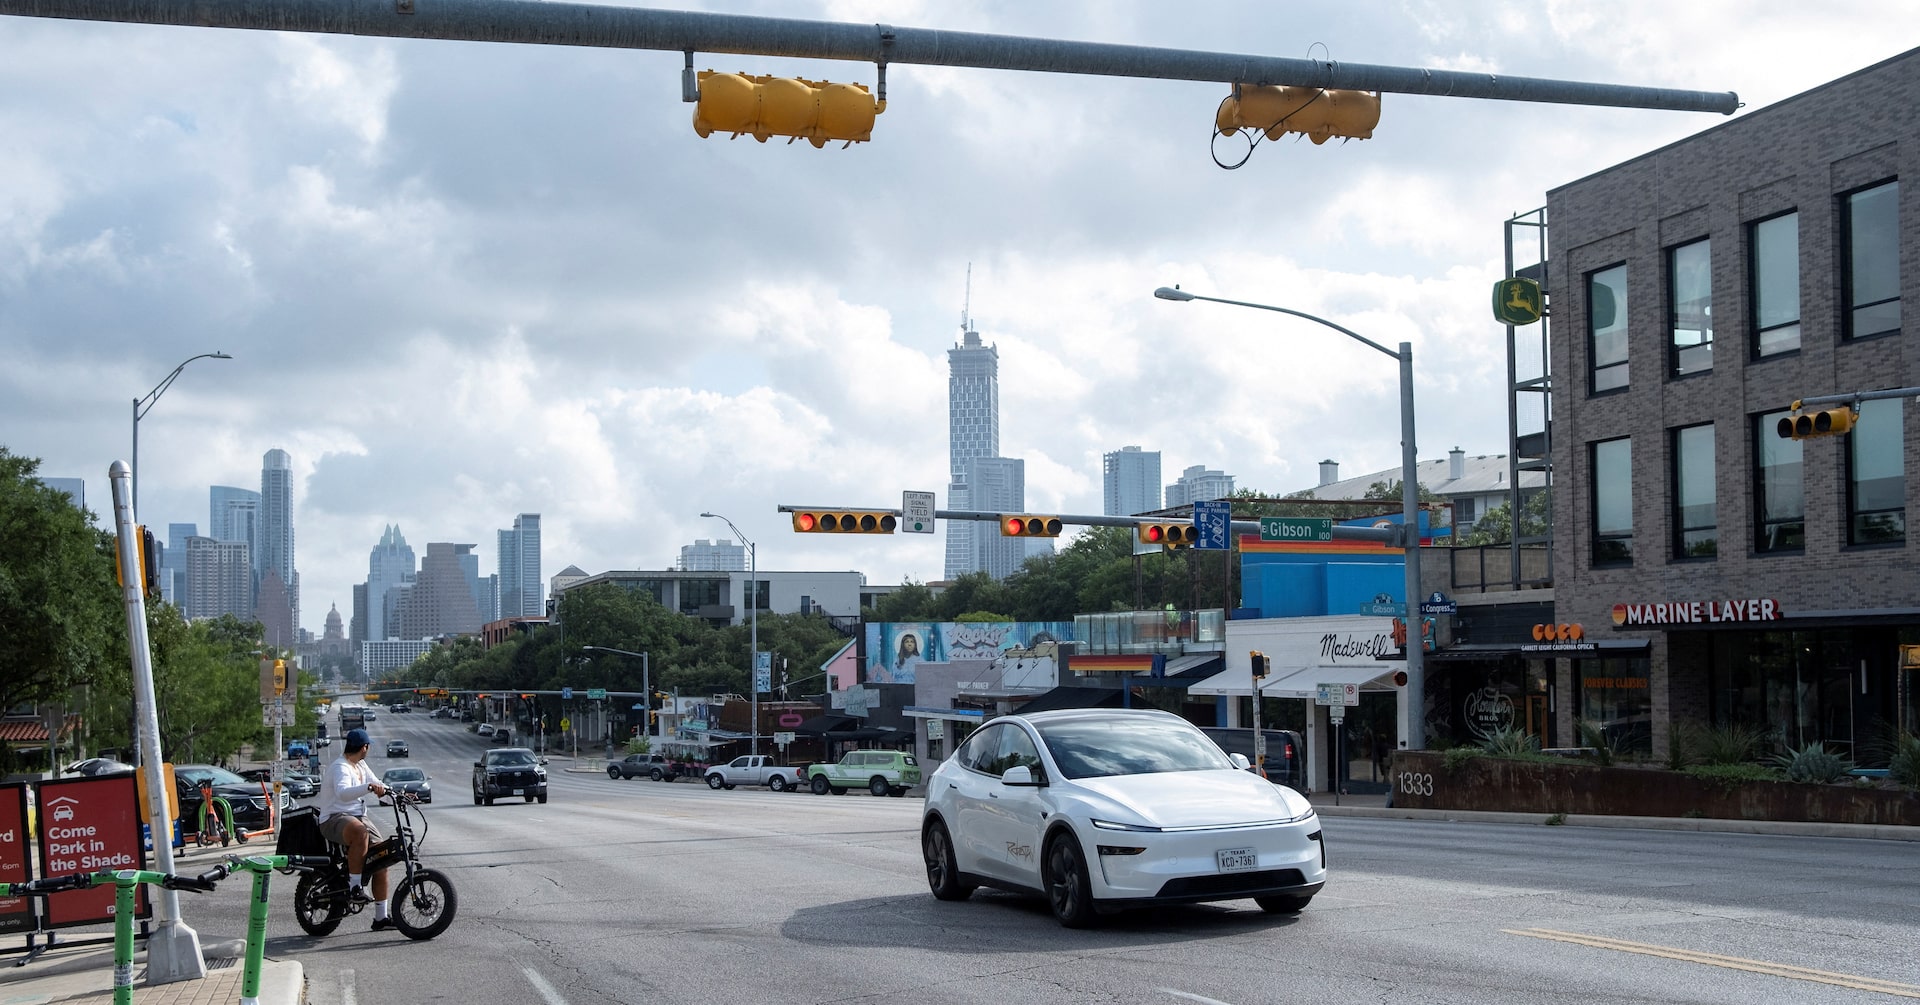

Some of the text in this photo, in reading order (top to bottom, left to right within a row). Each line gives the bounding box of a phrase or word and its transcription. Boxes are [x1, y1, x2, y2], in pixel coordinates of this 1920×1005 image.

[1262, 520, 1331, 537] E Gibson ST
[1318, 532, 1331, 540] 100
[1372, 605, 1395, 614] Gibson
[1425, 604, 1451, 614] Congress
[1626, 599, 1776, 625] MARINE LAYER
[1320, 633, 1388, 664] Madewell
[1583, 677, 1614, 688] FOREVER
[1398, 771, 1434, 796] 1333
[48, 825, 97, 840] Come
[50, 839, 105, 856] Park in
[2, 863, 20, 871] 6pm
[50, 853, 135, 872] the Shade.
